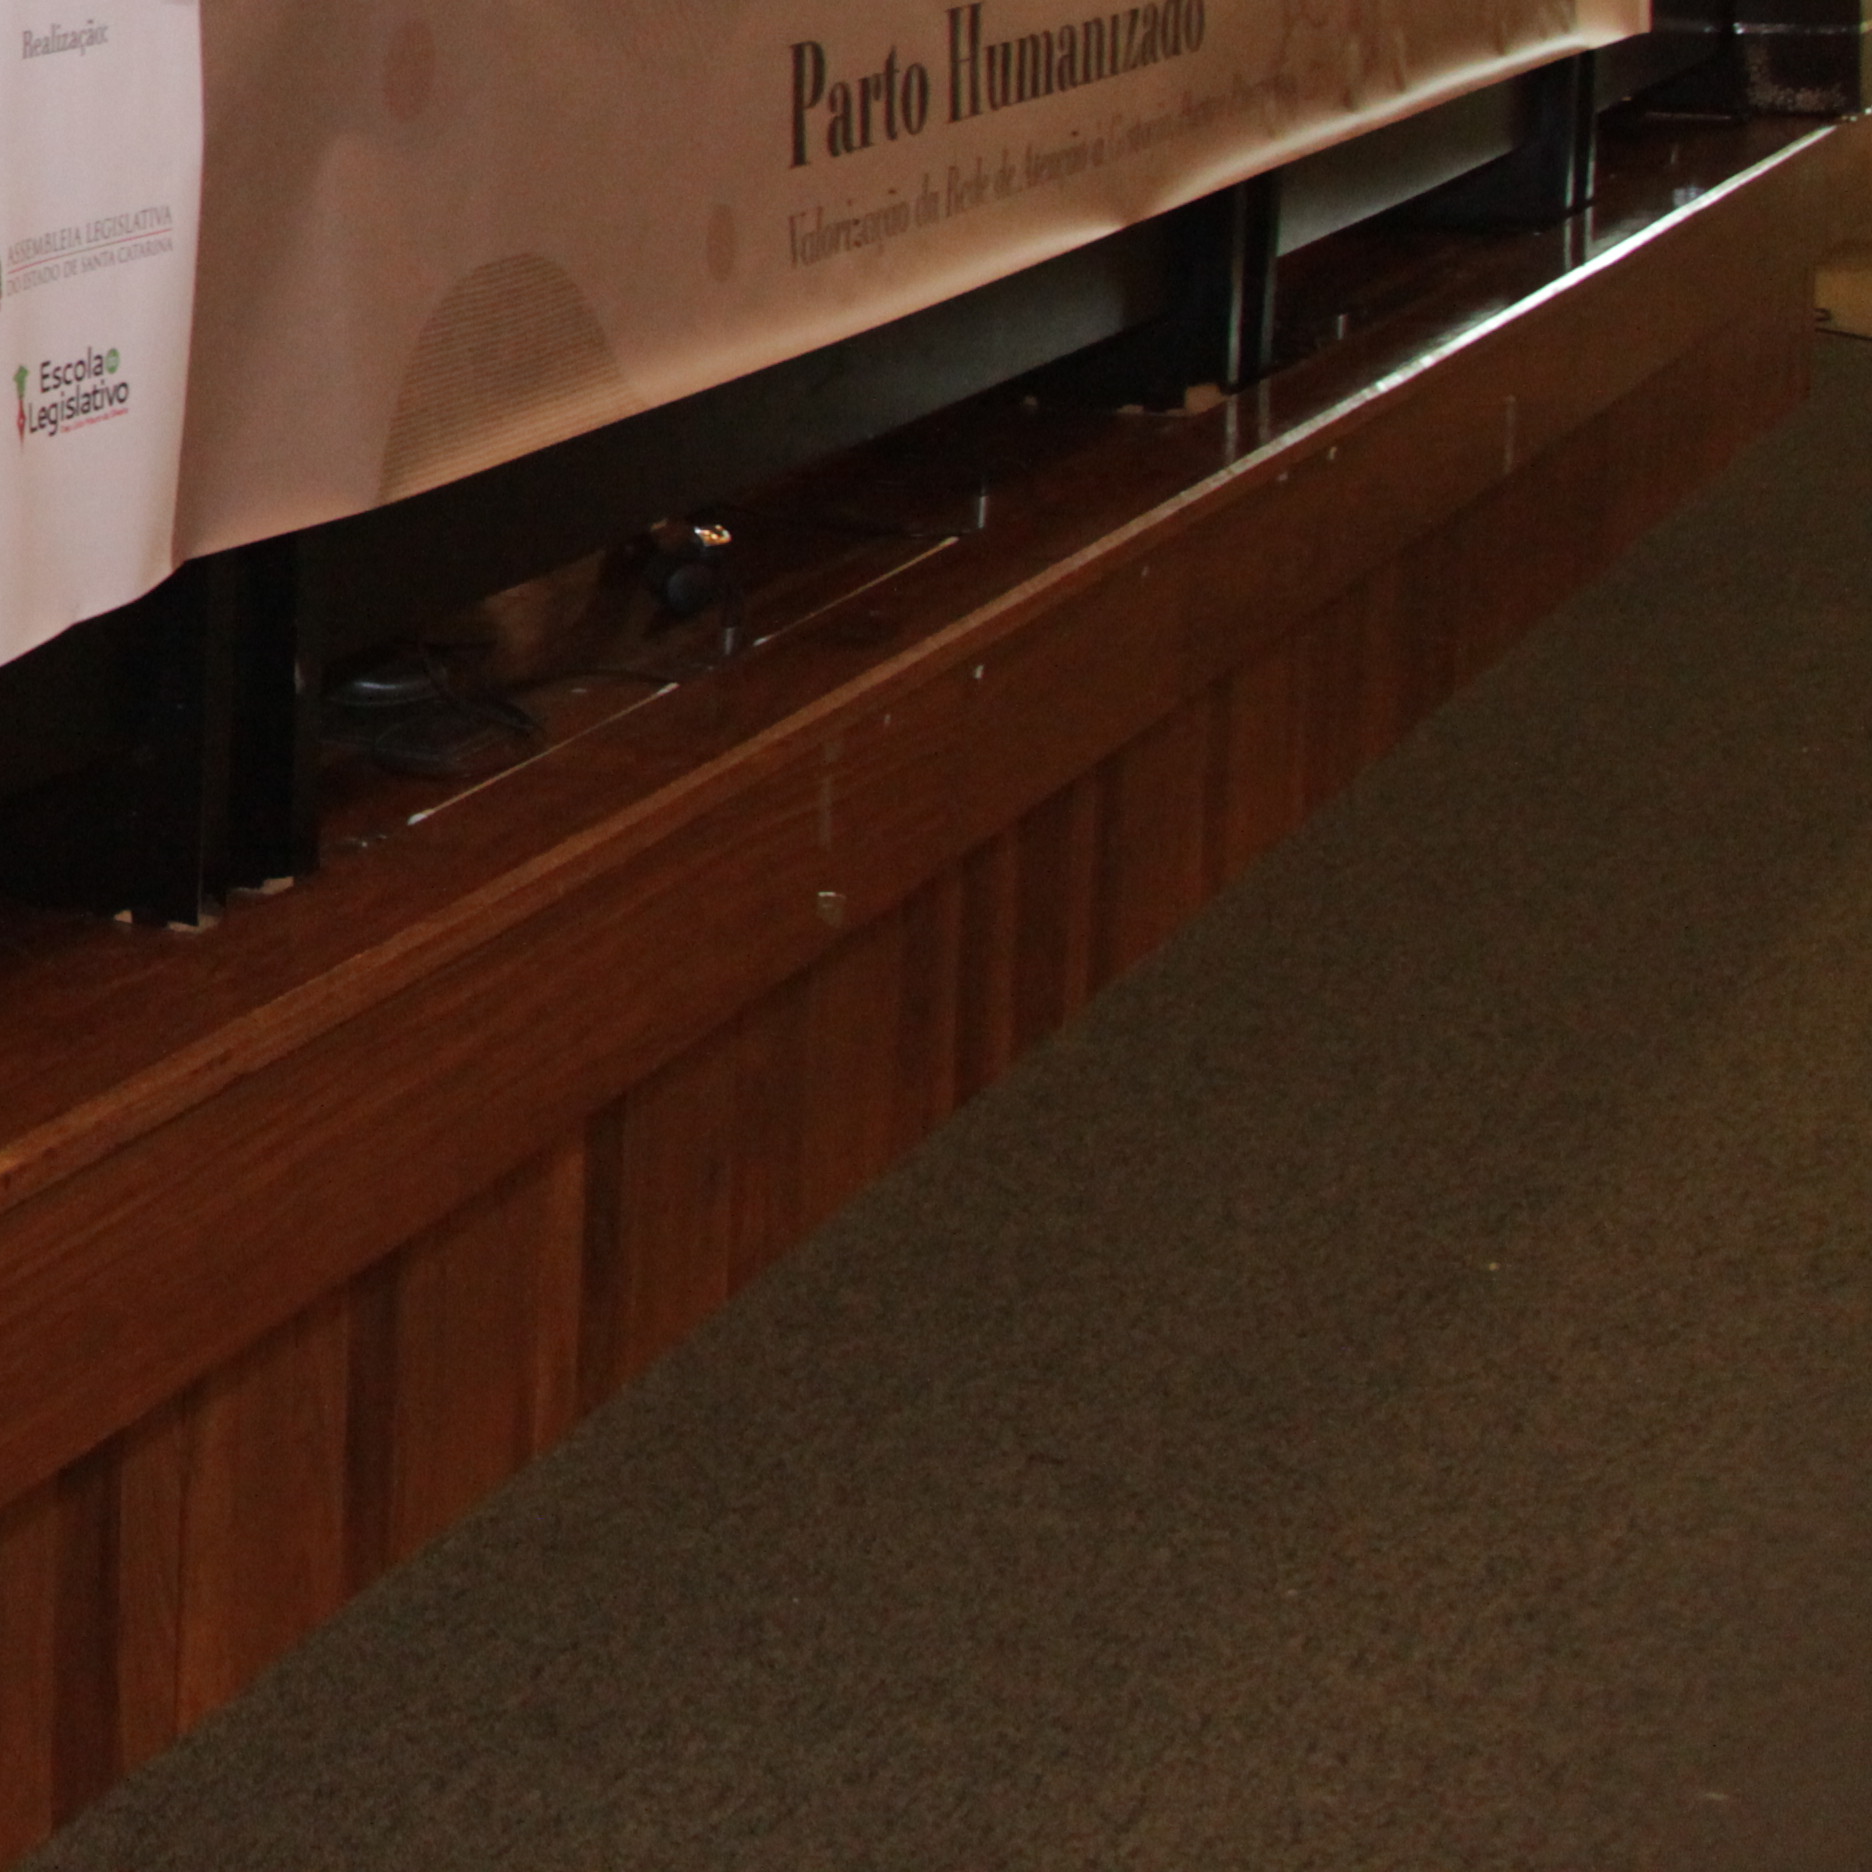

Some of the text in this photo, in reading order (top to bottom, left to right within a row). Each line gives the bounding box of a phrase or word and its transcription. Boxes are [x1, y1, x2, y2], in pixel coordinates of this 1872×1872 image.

[22, 19, 109, 59] Realização:
[789, 40, 930, 170] Parto
[7, 204, 173, 266] ASSEMBLEIA LEGISLATIVA
[788, 188, 911, 271] Valorização
[23, 263, 60, 291] ESTADO
[63, 257, 78, 279] DE
[81, 248, 115, 273] SANTA
[118, 236, 174, 264] CATARINA
[40, 345, 104, 394] Escola
[28, 379, 130, 437] Legislativo
